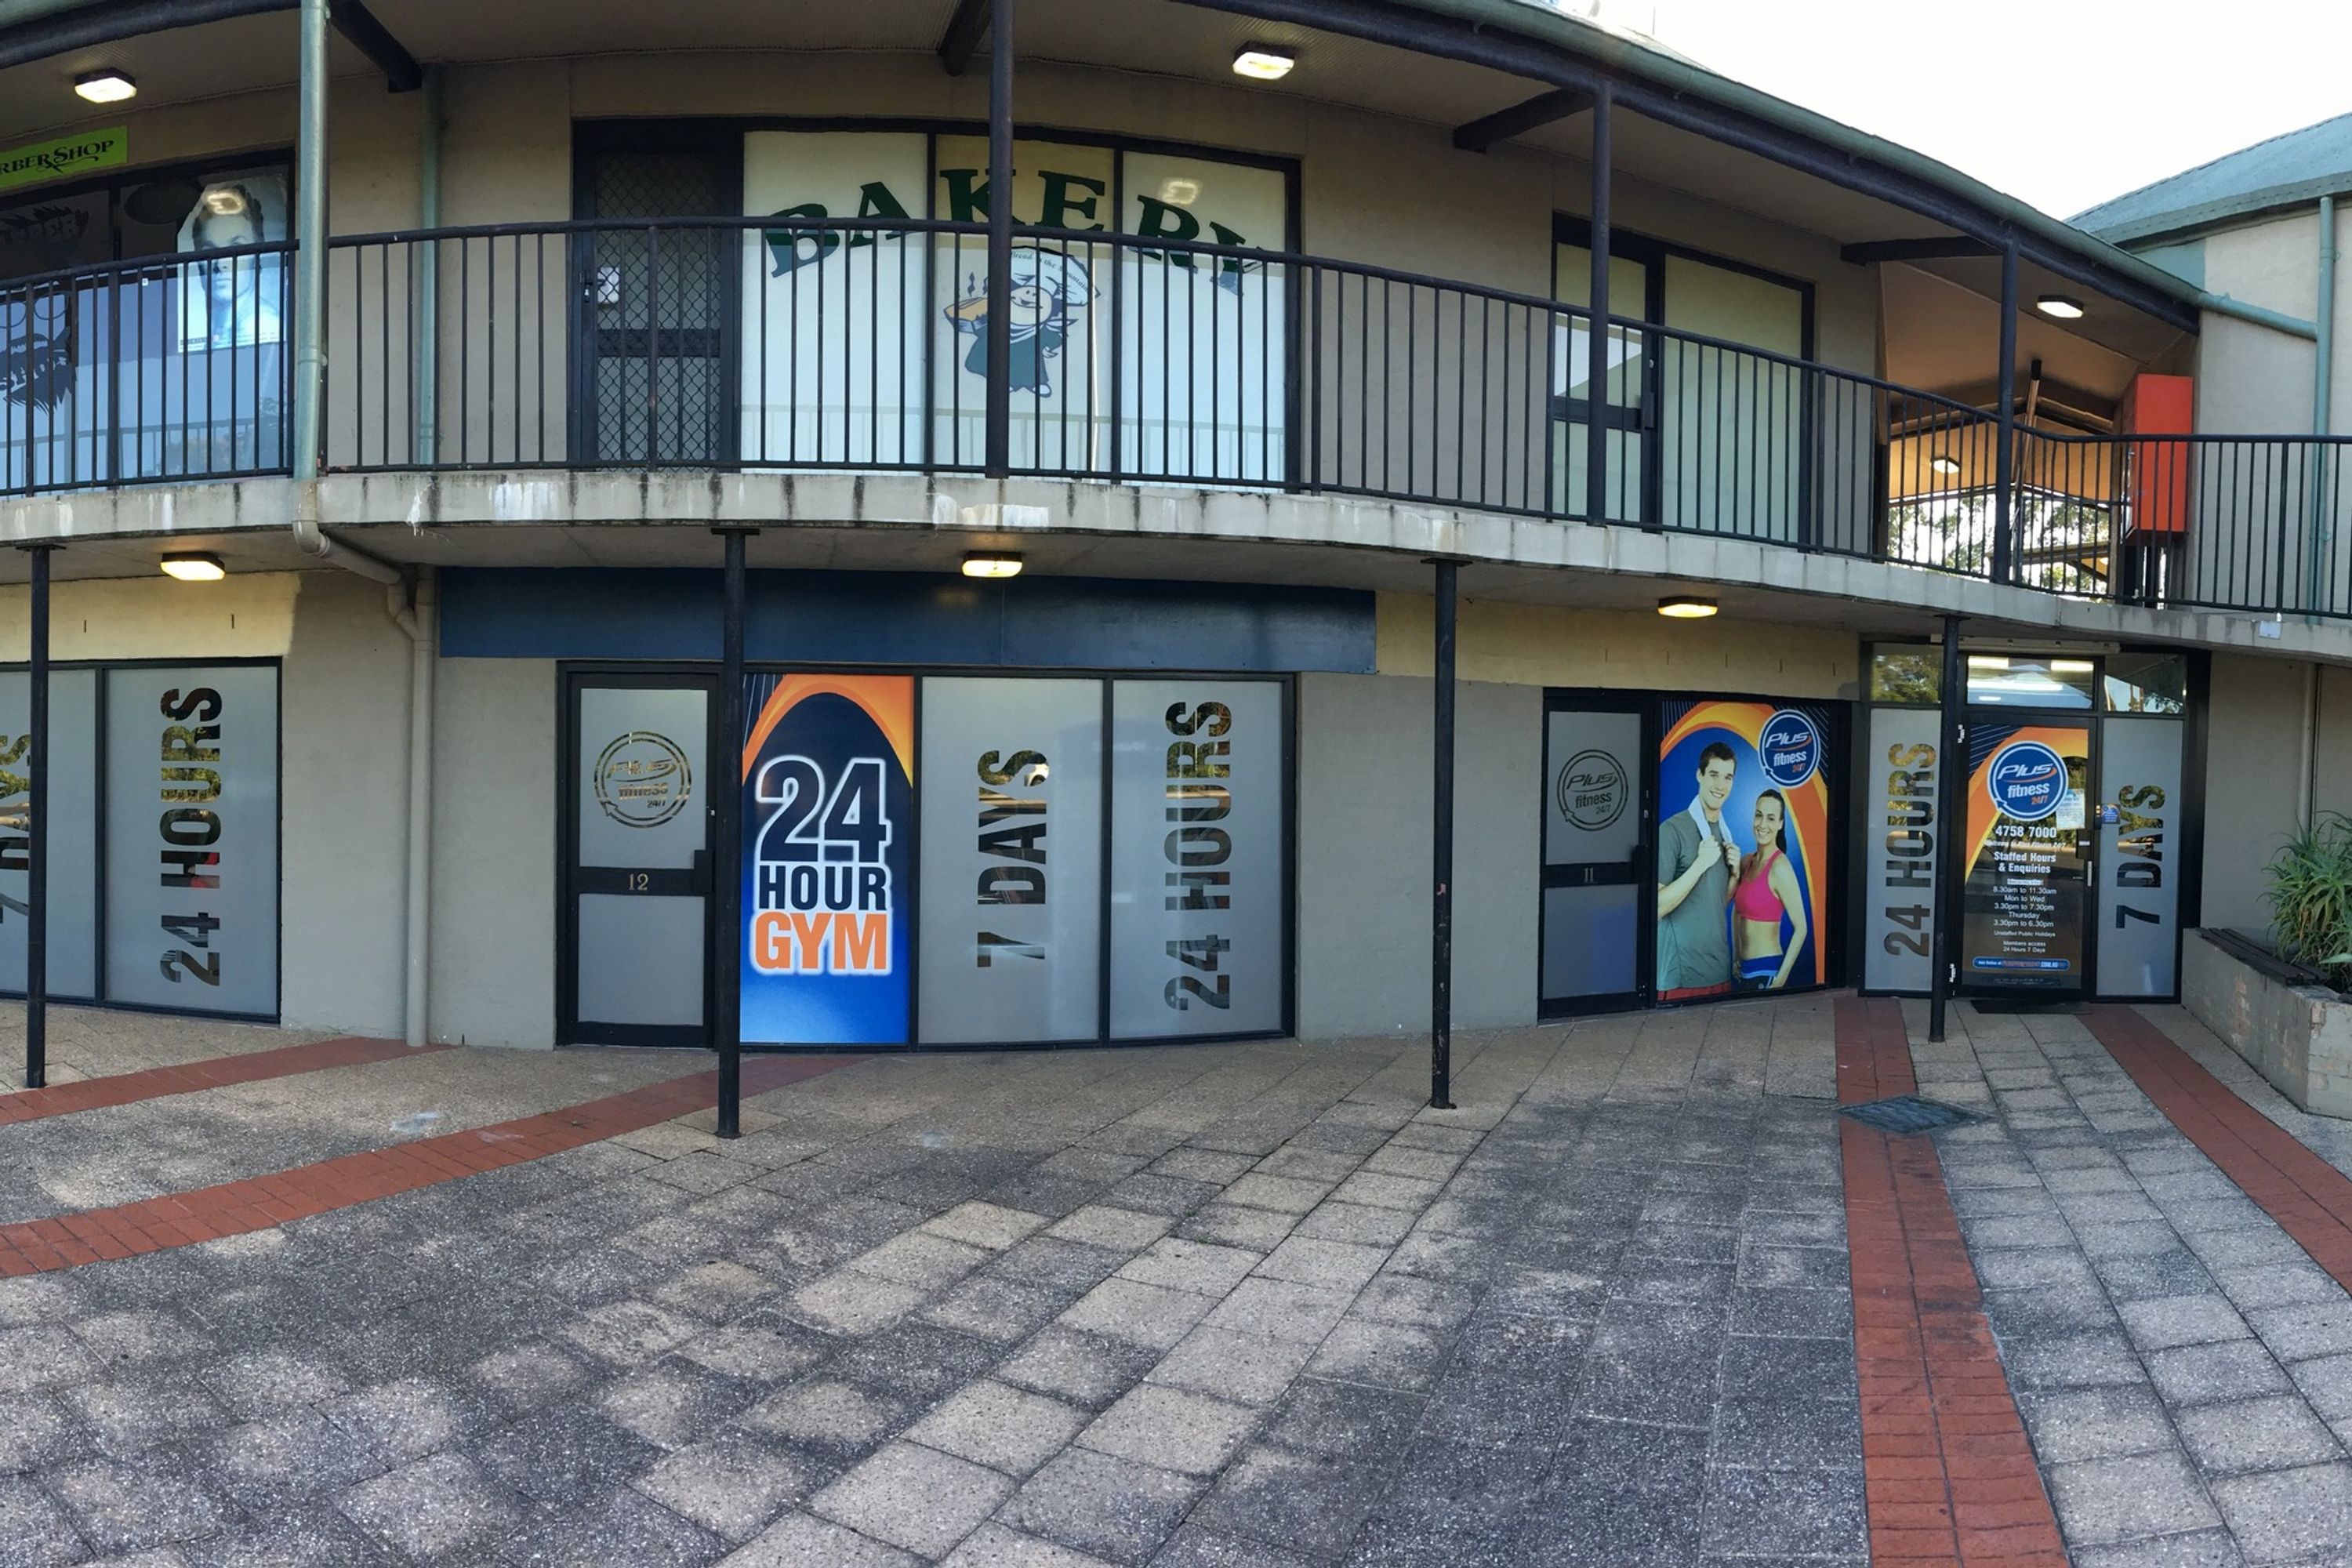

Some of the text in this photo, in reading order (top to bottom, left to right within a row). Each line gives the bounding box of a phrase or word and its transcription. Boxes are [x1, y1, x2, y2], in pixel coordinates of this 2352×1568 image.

[764, 168, 1263, 297] BAKERY
[1766, 731, 1809, 748] Plus
[1773, 751, 1807, 767] fitness
[1997, 763, 2054, 780] Plus
[1566, 772, 1615, 790] Plus
[2007, 783, 2050, 799] fitness
[758, 757, 889, 863] 24
[1575, 793, 1612, 809] fitness
[160, 688, 222, 986] 24 HOURS
[1995, 825, 2057, 838] 4758 7000
[977, 749, 1050, 967] 7 DAYS
[1164, 701, 1232, 1011] 24 HOURS
[1884, 743, 1936, 957] 24 HOURS
[1994, 851, 2056, 862] Staffed Hours
[2115, 785, 2165, 929] 7 DAYS
[1584, 868, 1595, 883] 11
[1998, 862, 2051, 874] & Enquiries
[628, 873, 649, 891] 12
[758, 865, 887, 911] HOUR
[2008, 911, 2040, 920] Thursday
[754, 911, 888, 971] GYM
